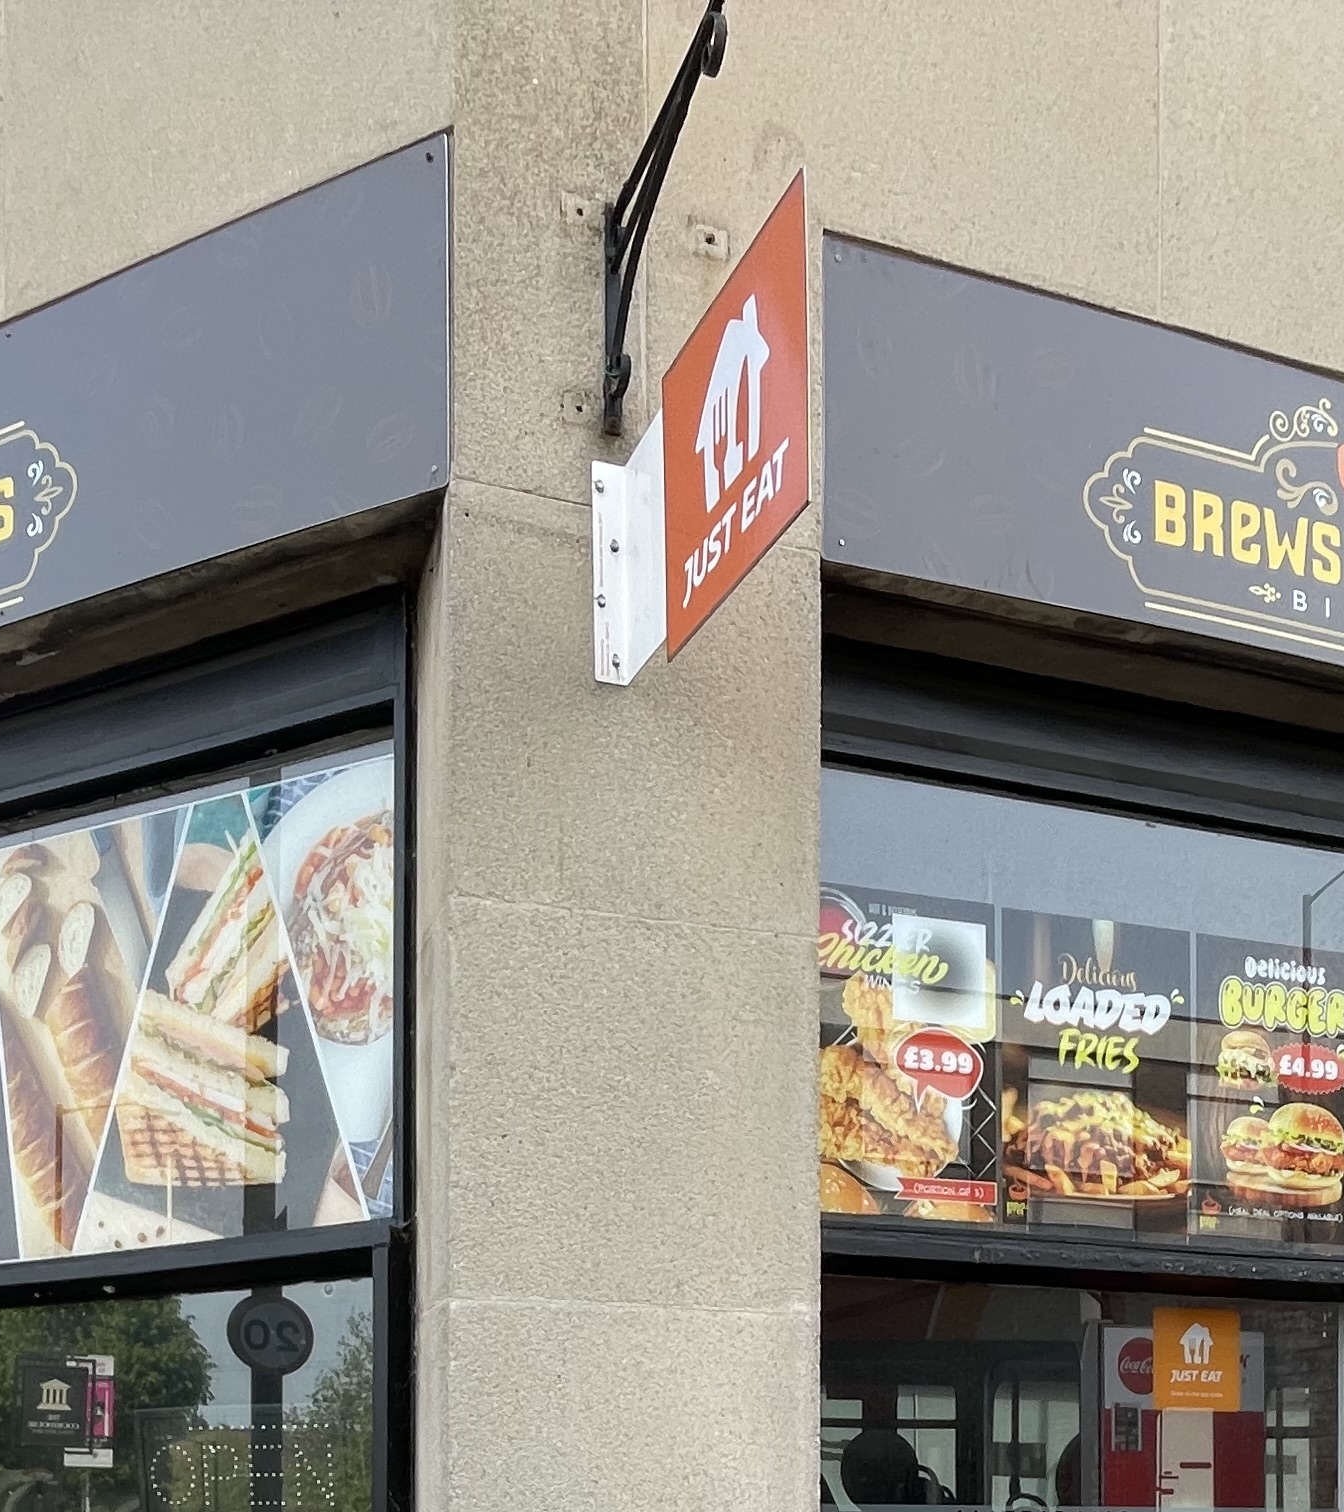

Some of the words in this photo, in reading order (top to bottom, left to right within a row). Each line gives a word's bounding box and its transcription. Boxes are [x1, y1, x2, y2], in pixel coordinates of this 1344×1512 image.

[682, 511, 737, 609] JUST
[740, 437, 790, 534] EAT
[1058, 952, 1138, 992] Delicious
[1022, 980, 1173, 1036] LOADED
[903, 1046, 974, 1076] £3.99
[1057, 1028, 1141, 1075] FRIES
[1278, 1053, 1340, 1081] £4.99
[1170, 1369, 1200, 1383] JUST
[1200, 1370, 1223, 1383] EAT
[150, 1442, 336, 1507] OPEN
